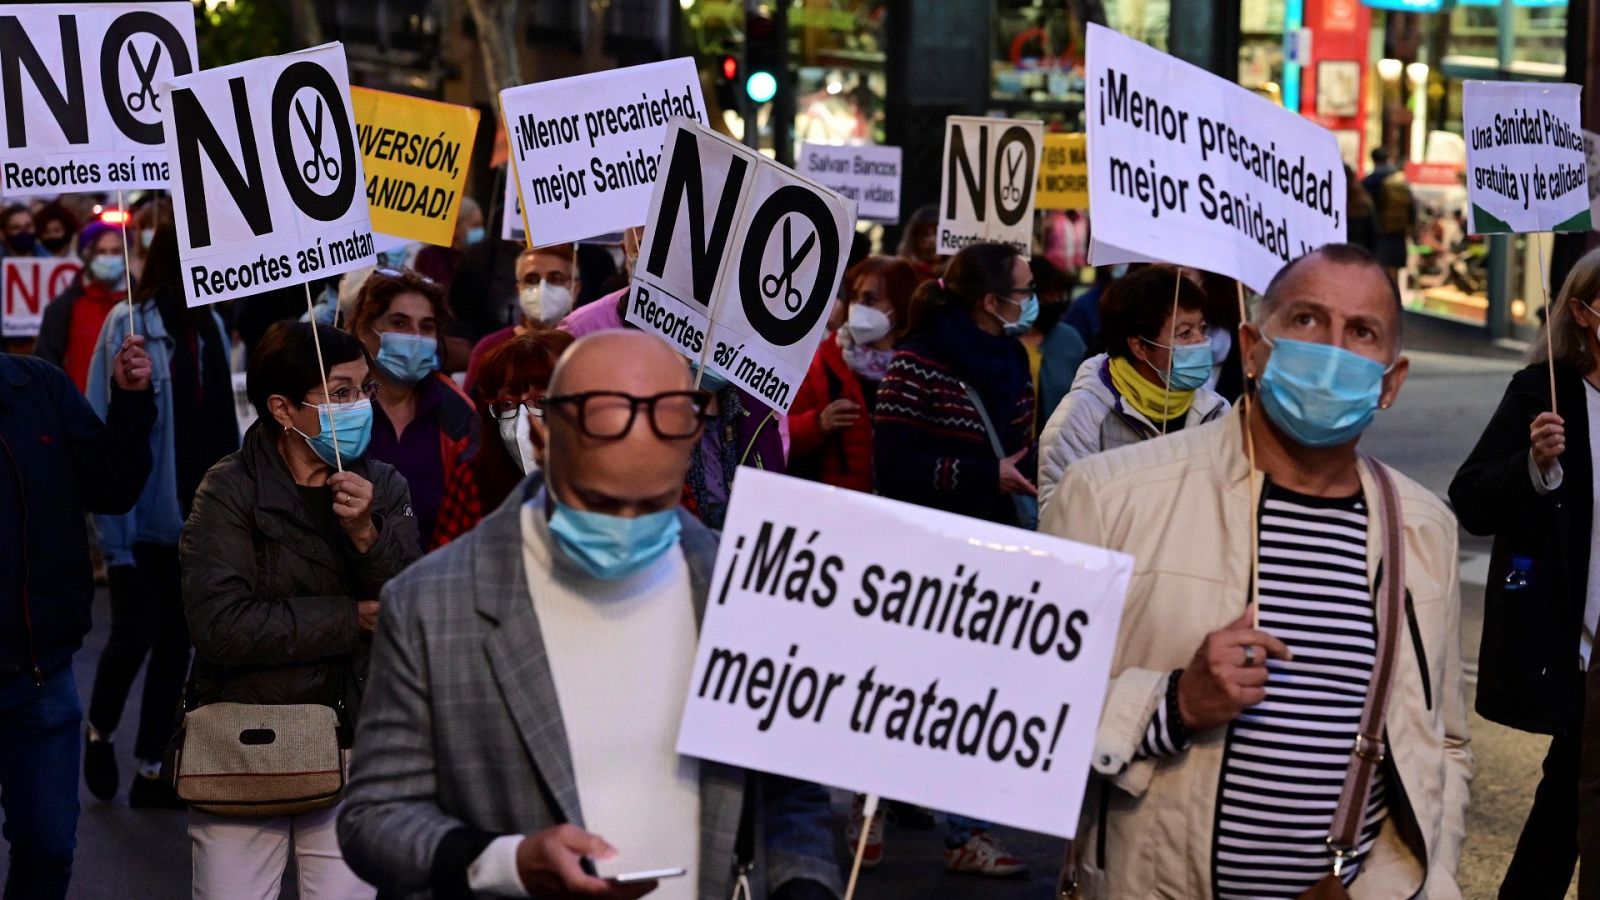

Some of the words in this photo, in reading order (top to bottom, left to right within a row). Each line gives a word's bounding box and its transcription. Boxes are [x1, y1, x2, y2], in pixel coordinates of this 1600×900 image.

[0, 11, 193, 148] NO
[514, 113, 580, 161] ¡Menor
[584, 85, 702, 147] precariedad,
[5, 159, 102, 188] Recortes
[107, 156, 136, 182] así
[171, 61, 357, 249] NO
[1099, 68, 1189, 143] ¡Menor
[1197, 114, 1339, 230] precariedad,
[1494, 108, 1543, 147] Sanidad
[1543, 109, 1584, 152] Pública
[364, 173, 455, 221] ANIDAD!
[531, 163, 587, 209] mejor
[946, 124, 1036, 226] NO
[1109, 156, 1189, 218] mejor
[1475, 163, 1519, 201] gratuita
[1520, 173, 1530, 210] y
[1533, 163, 1547, 200] de
[1549, 163, 1586, 201] calidad!
[190, 253, 291, 298] Recortes
[297, 237, 327, 273] así
[647, 127, 840, 347] NO
[633, 286, 704, 353] Recortes
[713, 341, 746, 371] así
[735, 355, 788, 410] matan.
[718, 520, 844, 608] ¡Más
[853, 563, 1089, 662] sanitarios
[698, 645, 845, 732] mejor
[849, 665, 1070, 773] tratados!
